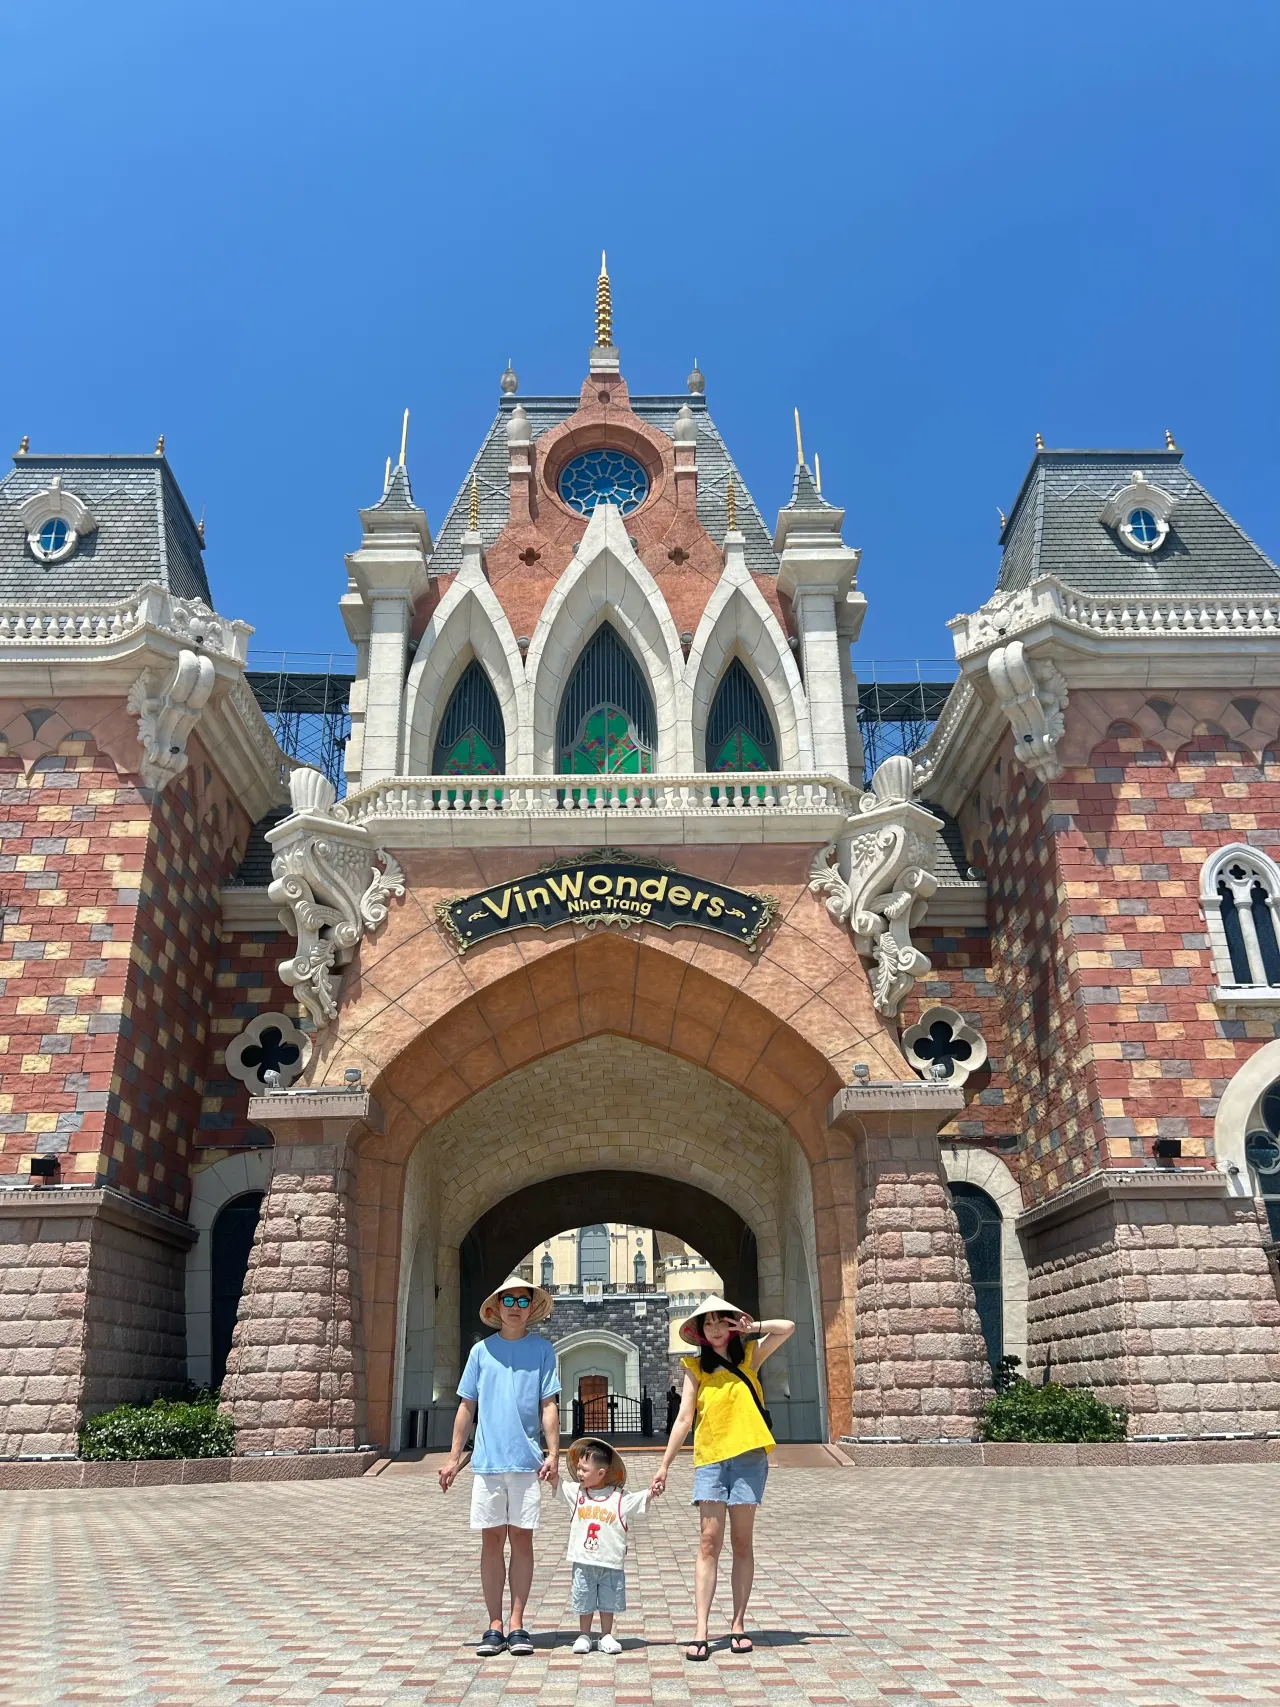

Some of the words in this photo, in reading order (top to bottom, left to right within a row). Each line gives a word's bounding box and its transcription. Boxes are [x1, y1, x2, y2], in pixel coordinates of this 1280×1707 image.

[481, 871, 725, 919] VinWonders
[567, 899, 602, 914] Nha
[605, 896, 652, 916] Trang
